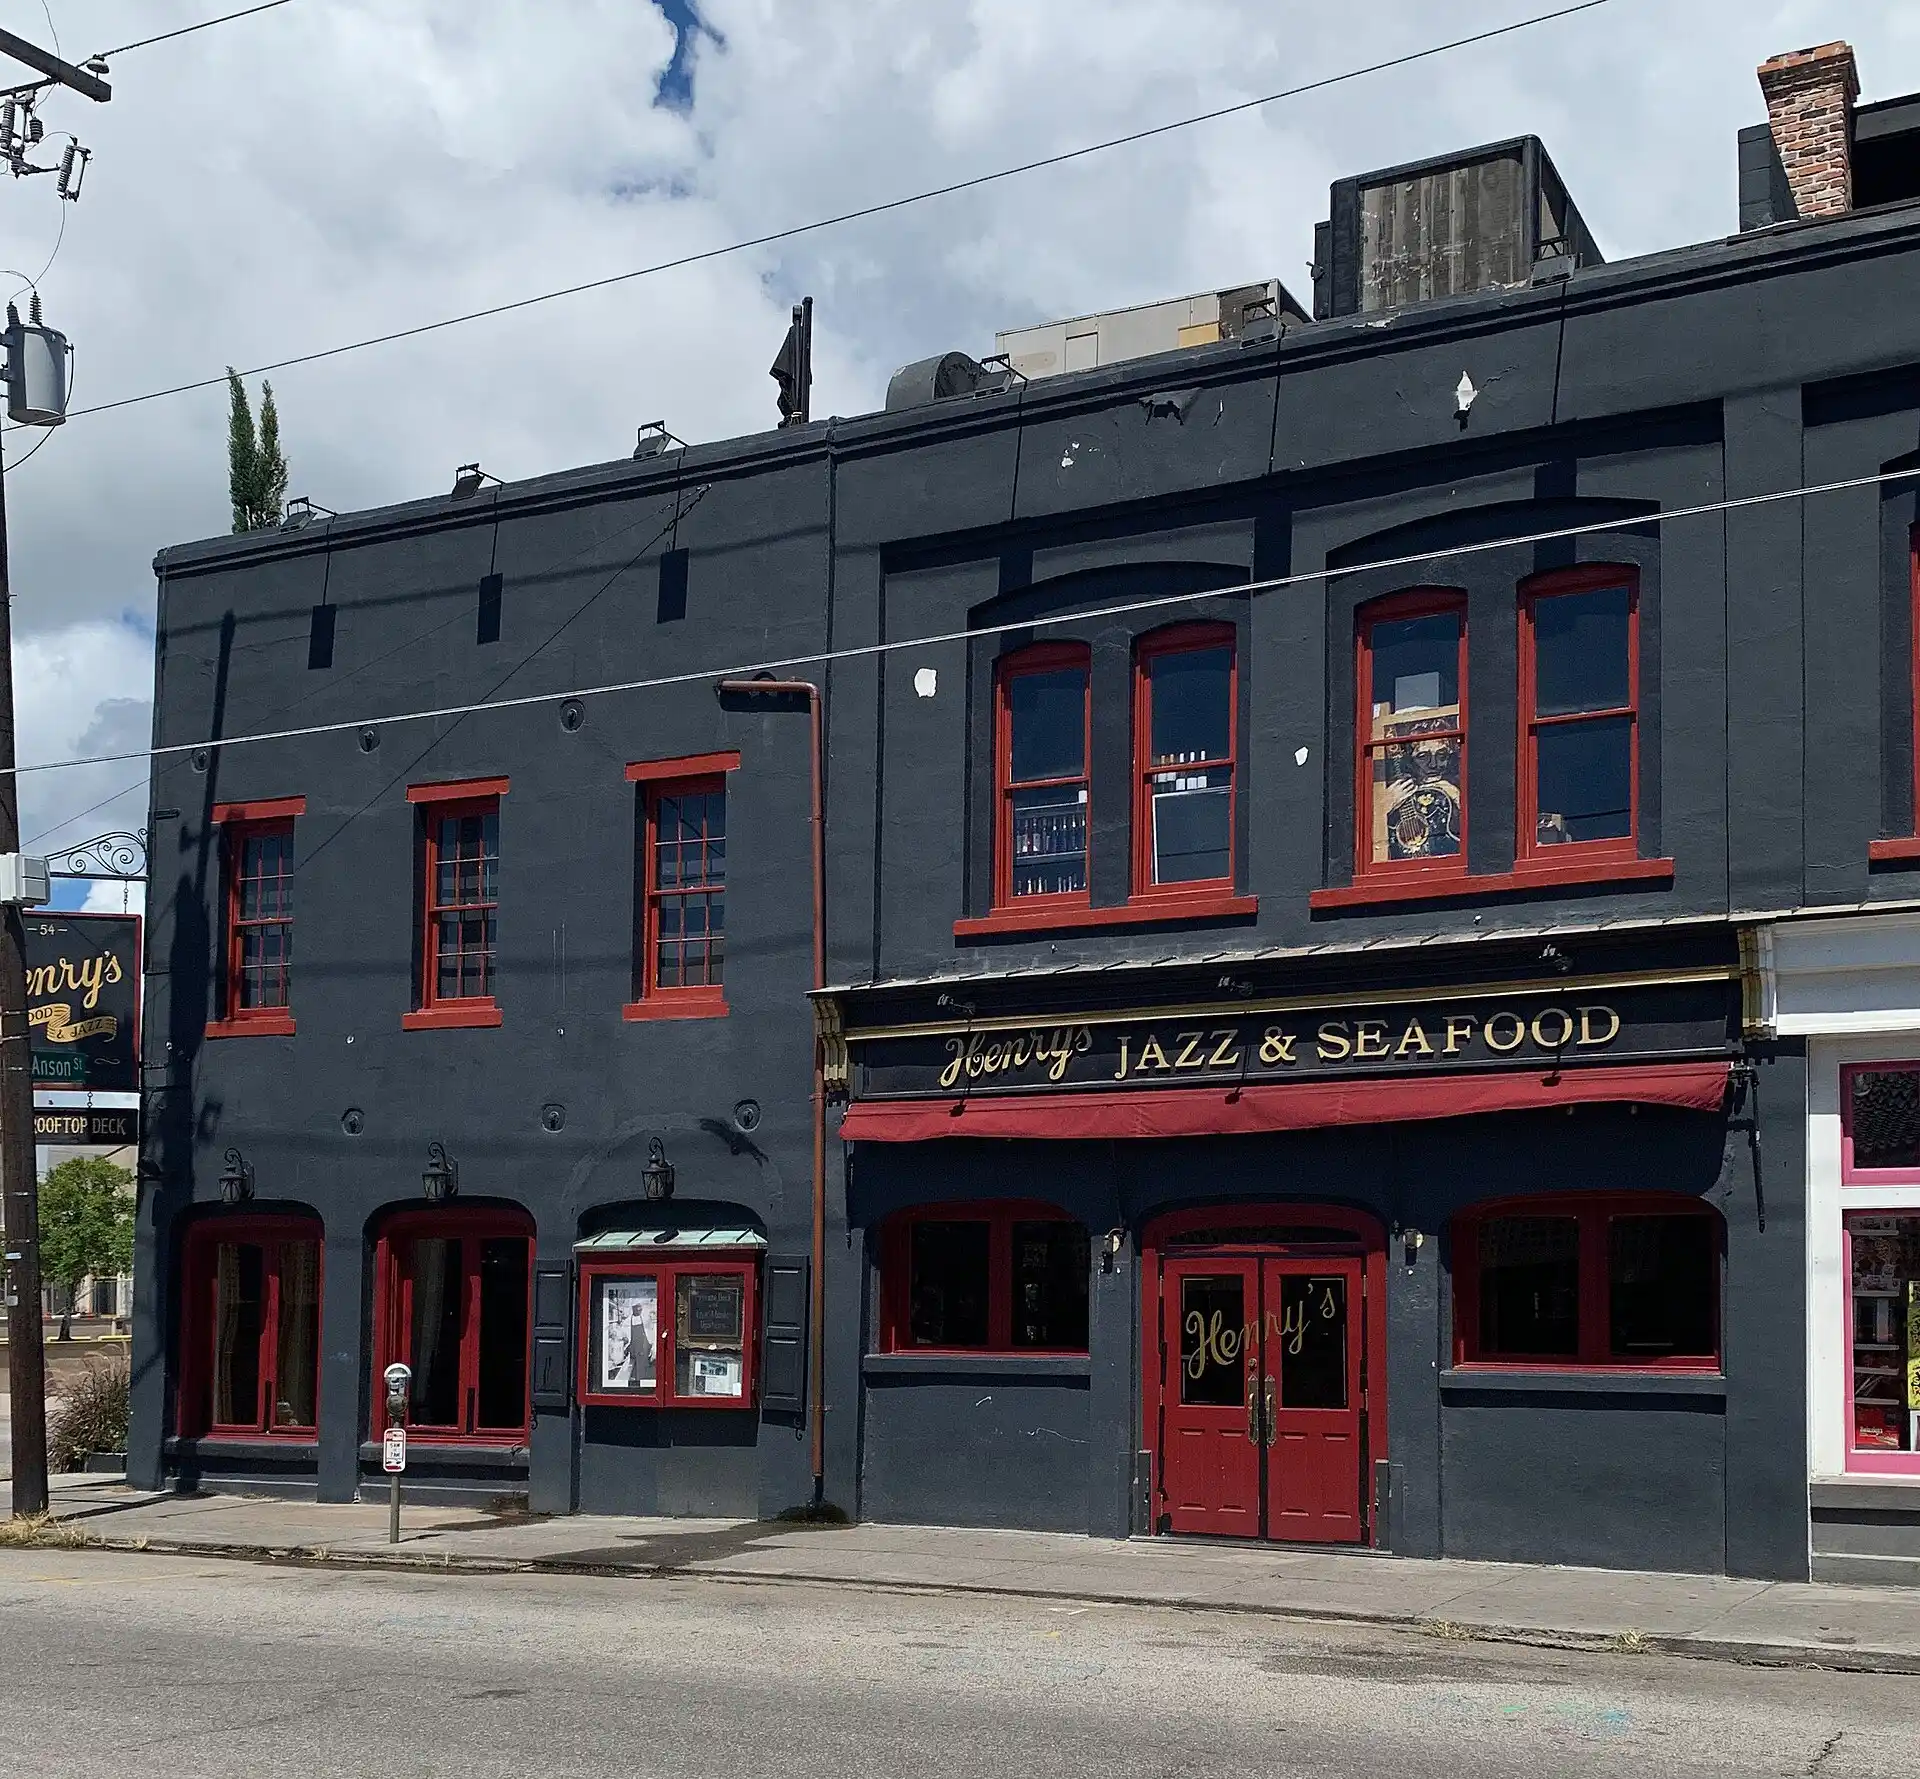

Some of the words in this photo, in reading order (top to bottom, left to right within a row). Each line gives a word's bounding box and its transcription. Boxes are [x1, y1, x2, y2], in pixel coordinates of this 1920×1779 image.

[69, 1018, 104, 1037] JAZZ
[1114, 1027, 1240, 1079] JAZZ
[1258, 1025, 1297, 1063] &
[1317, 1004, 1621, 1060] SEAFOOD
[32, 1055, 71, 1076] Anson
[73, 1057, 83, 1070] St
[92, 1117, 126, 1136] DECK
[1185, 1282, 1336, 1380] Henry's
